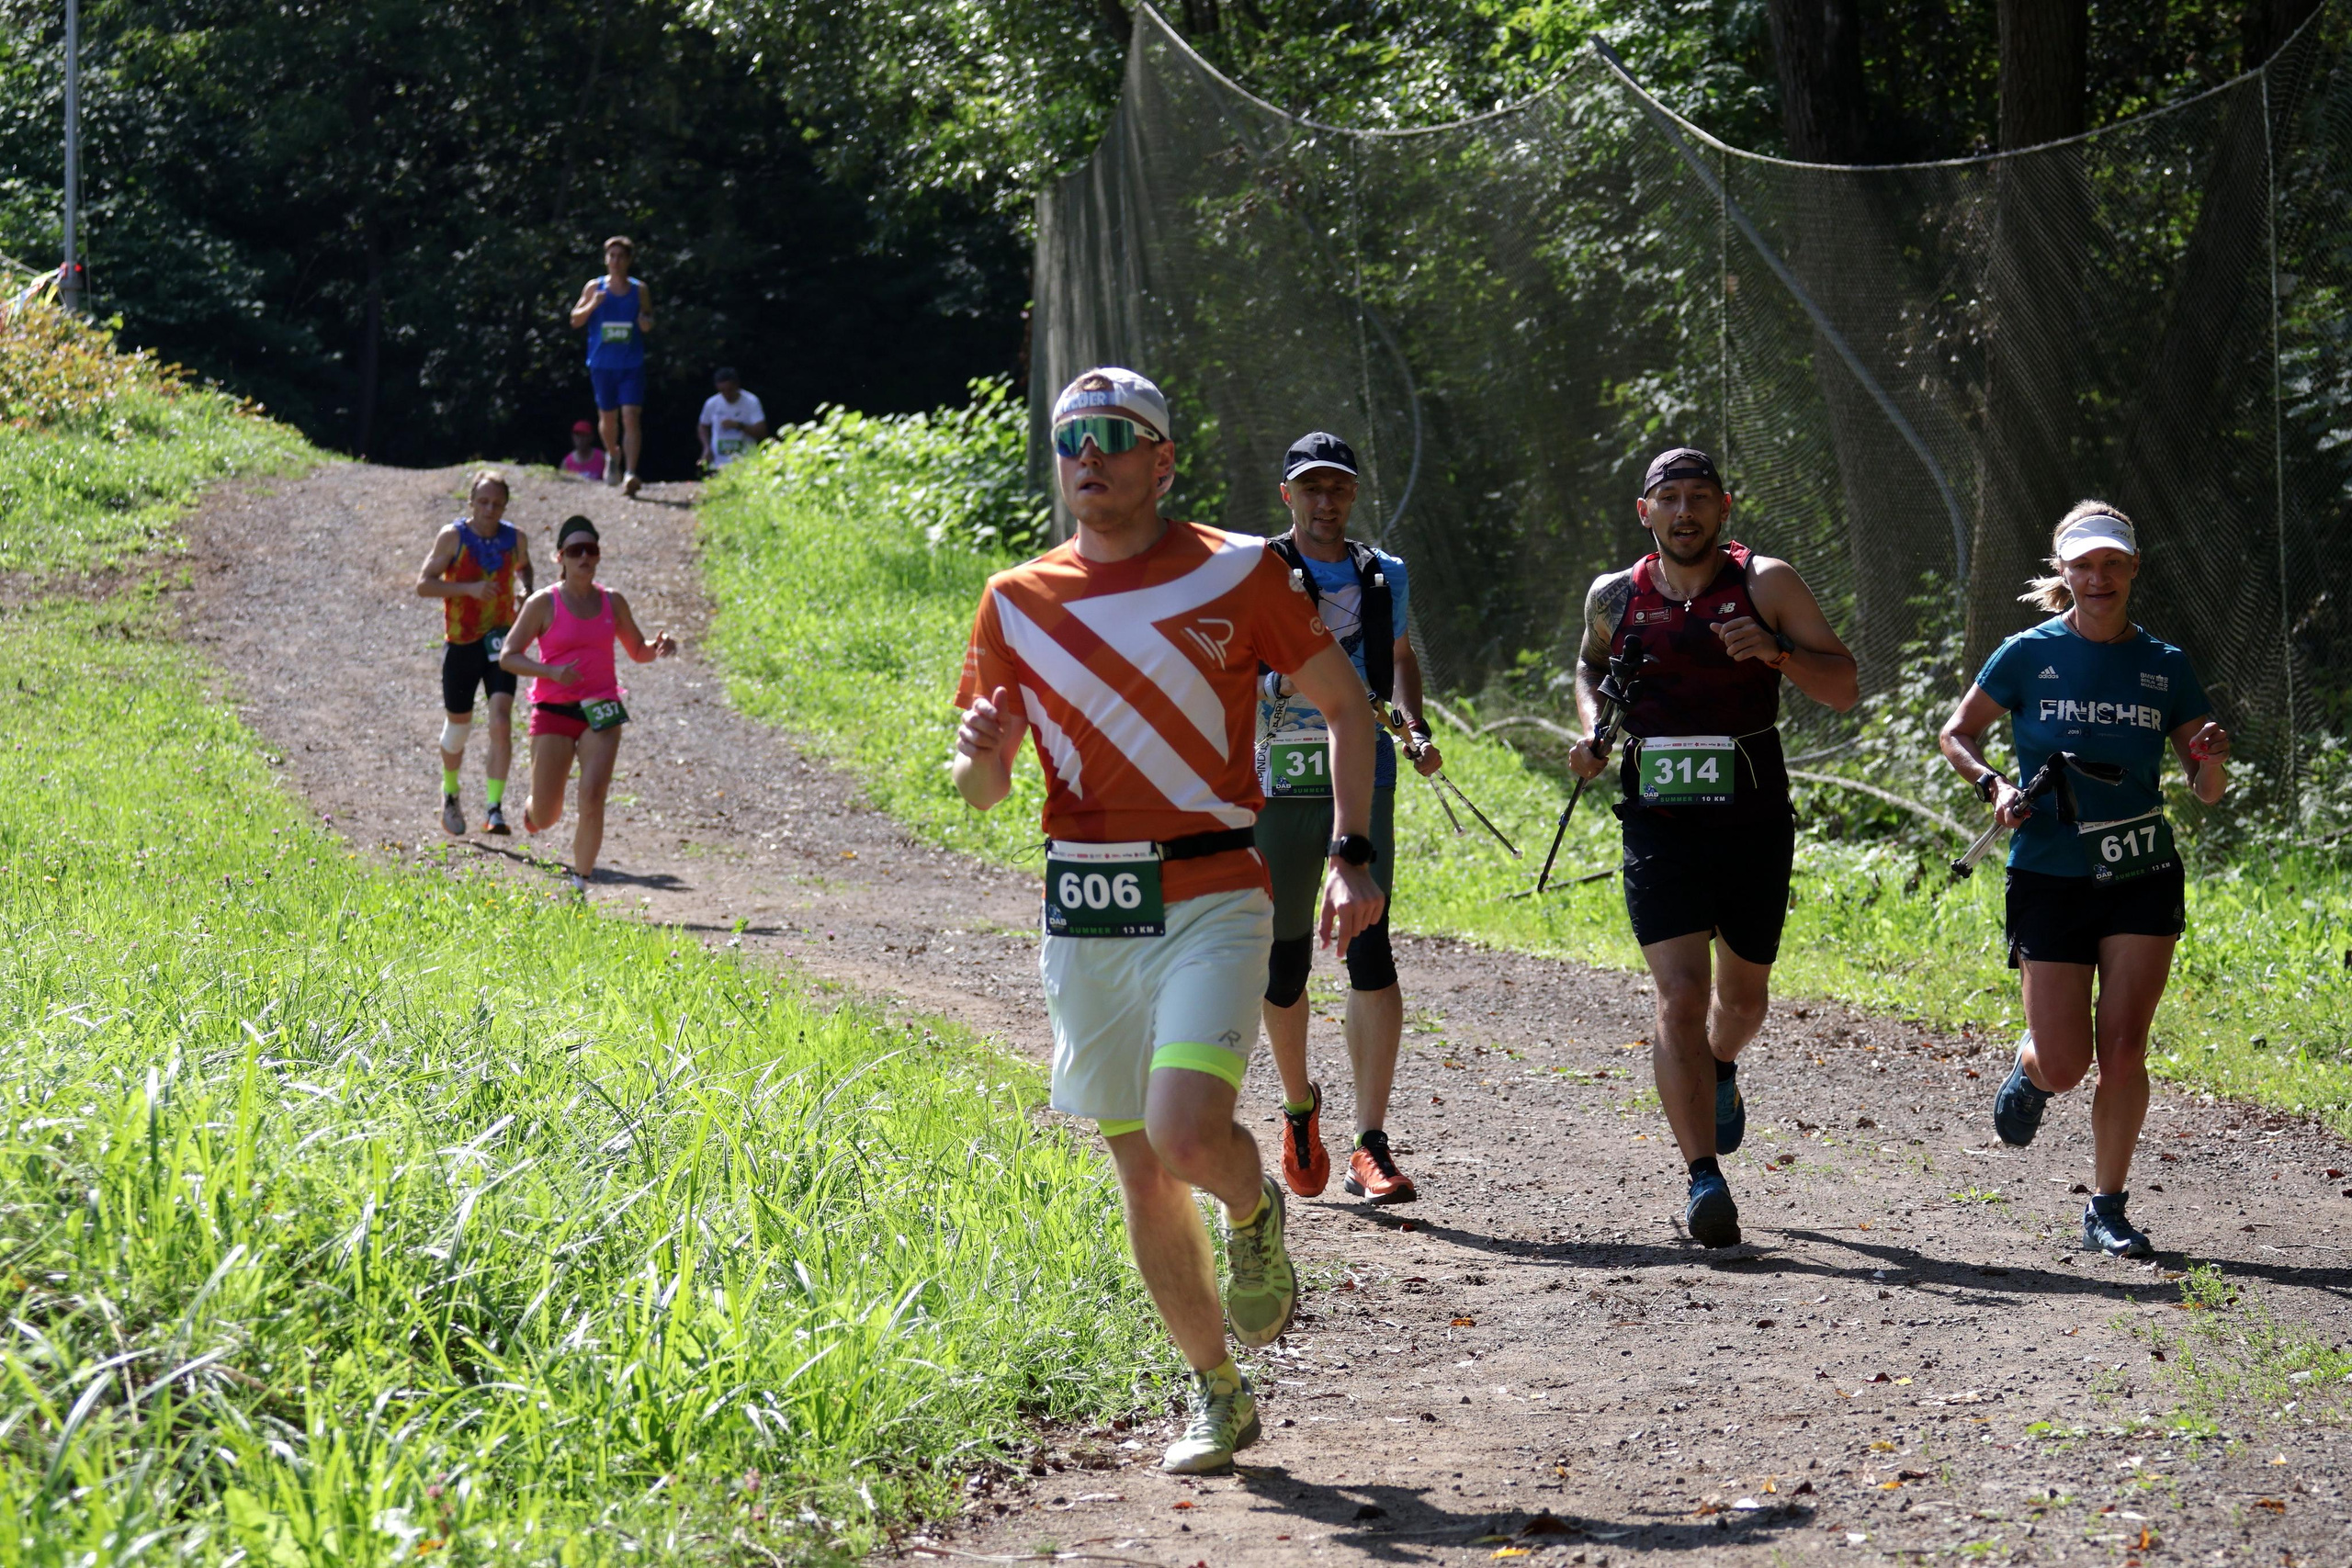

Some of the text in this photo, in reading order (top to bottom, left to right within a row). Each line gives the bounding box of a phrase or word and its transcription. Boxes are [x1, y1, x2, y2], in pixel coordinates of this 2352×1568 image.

[2111, 528, 2131, 539] 2XU
[592, 701, 620, 721] 337
[2039, 699, 2162, 731] FINISHER
[1654, 757, 1720, 784] 314
[2100, 825, 2156, 863] 617
[2096, 871, 2113, 880] DAB
[2115, 869, 2145, 881] SUMMER
[1058, 872, 1142, 909] 606
[1049, 917, 1067, 927] DAB
[1069, 926, 1111, 934] SUMMER
[1123, 926, 1135, 934] 13
